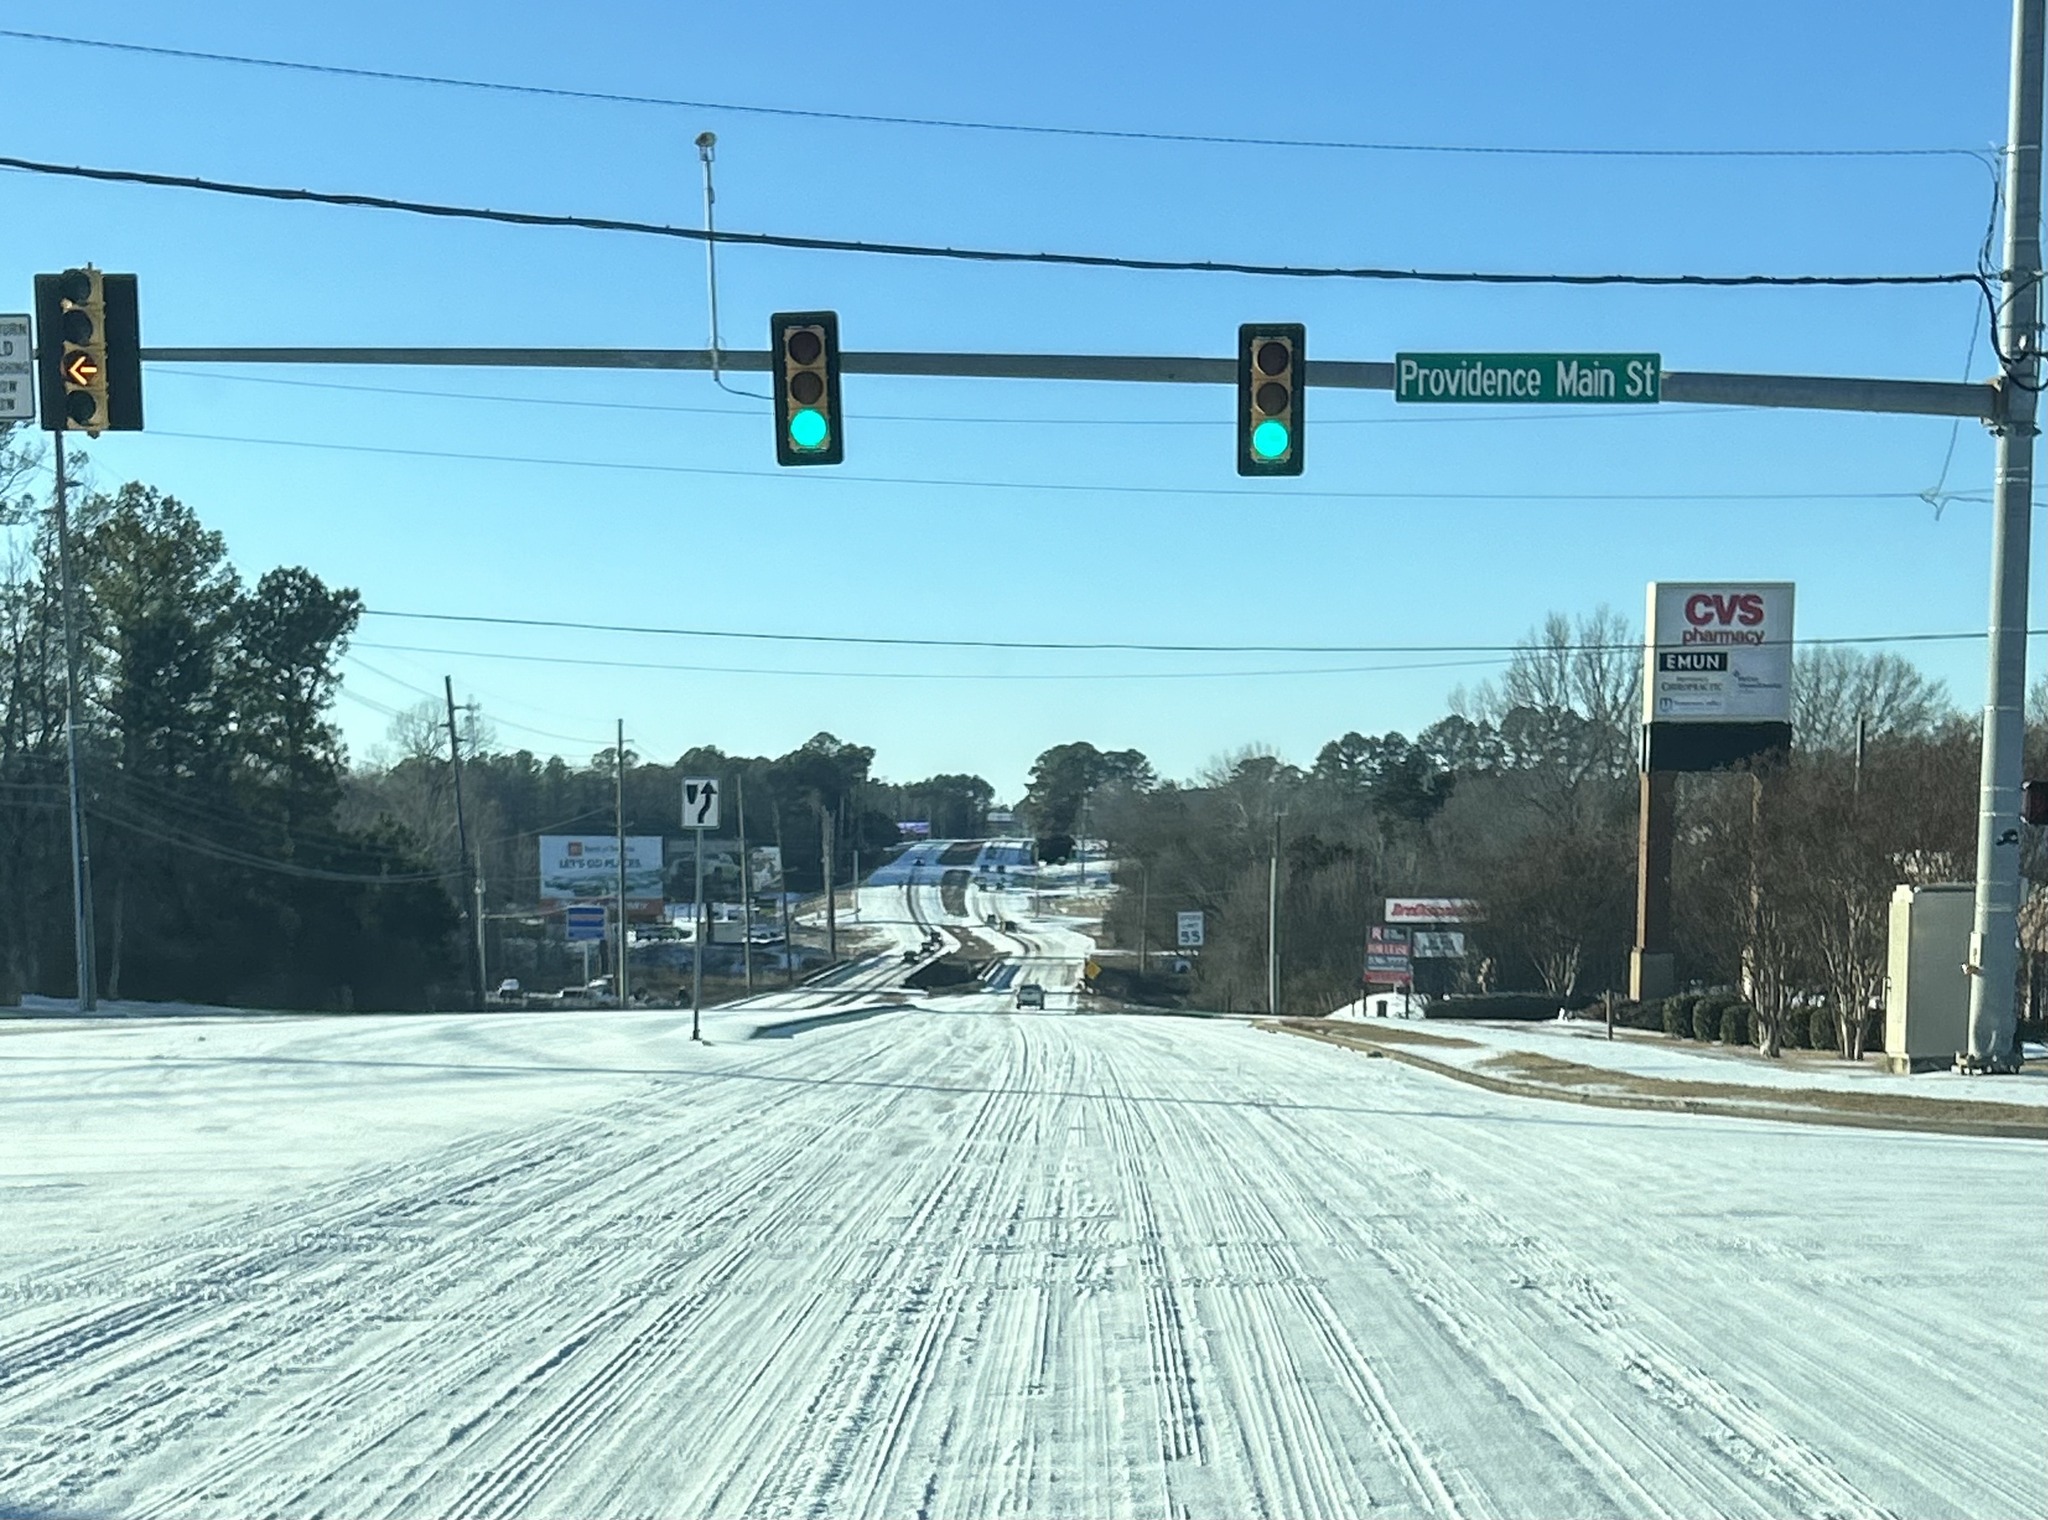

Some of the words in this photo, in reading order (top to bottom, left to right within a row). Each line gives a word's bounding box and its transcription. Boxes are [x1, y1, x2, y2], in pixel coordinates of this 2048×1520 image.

[1400, 360, 1541, 397] Providence
[1556, 360, 1615, 397] Main
[1625, 360, 1655, 397] St
[1685, 593, 1764, 626] CVS
[1682, 628, 1765, 646] pharmacy
[1666, 654, 1720, 669] EMUN
[1181, 930, 1201, 943] 55
